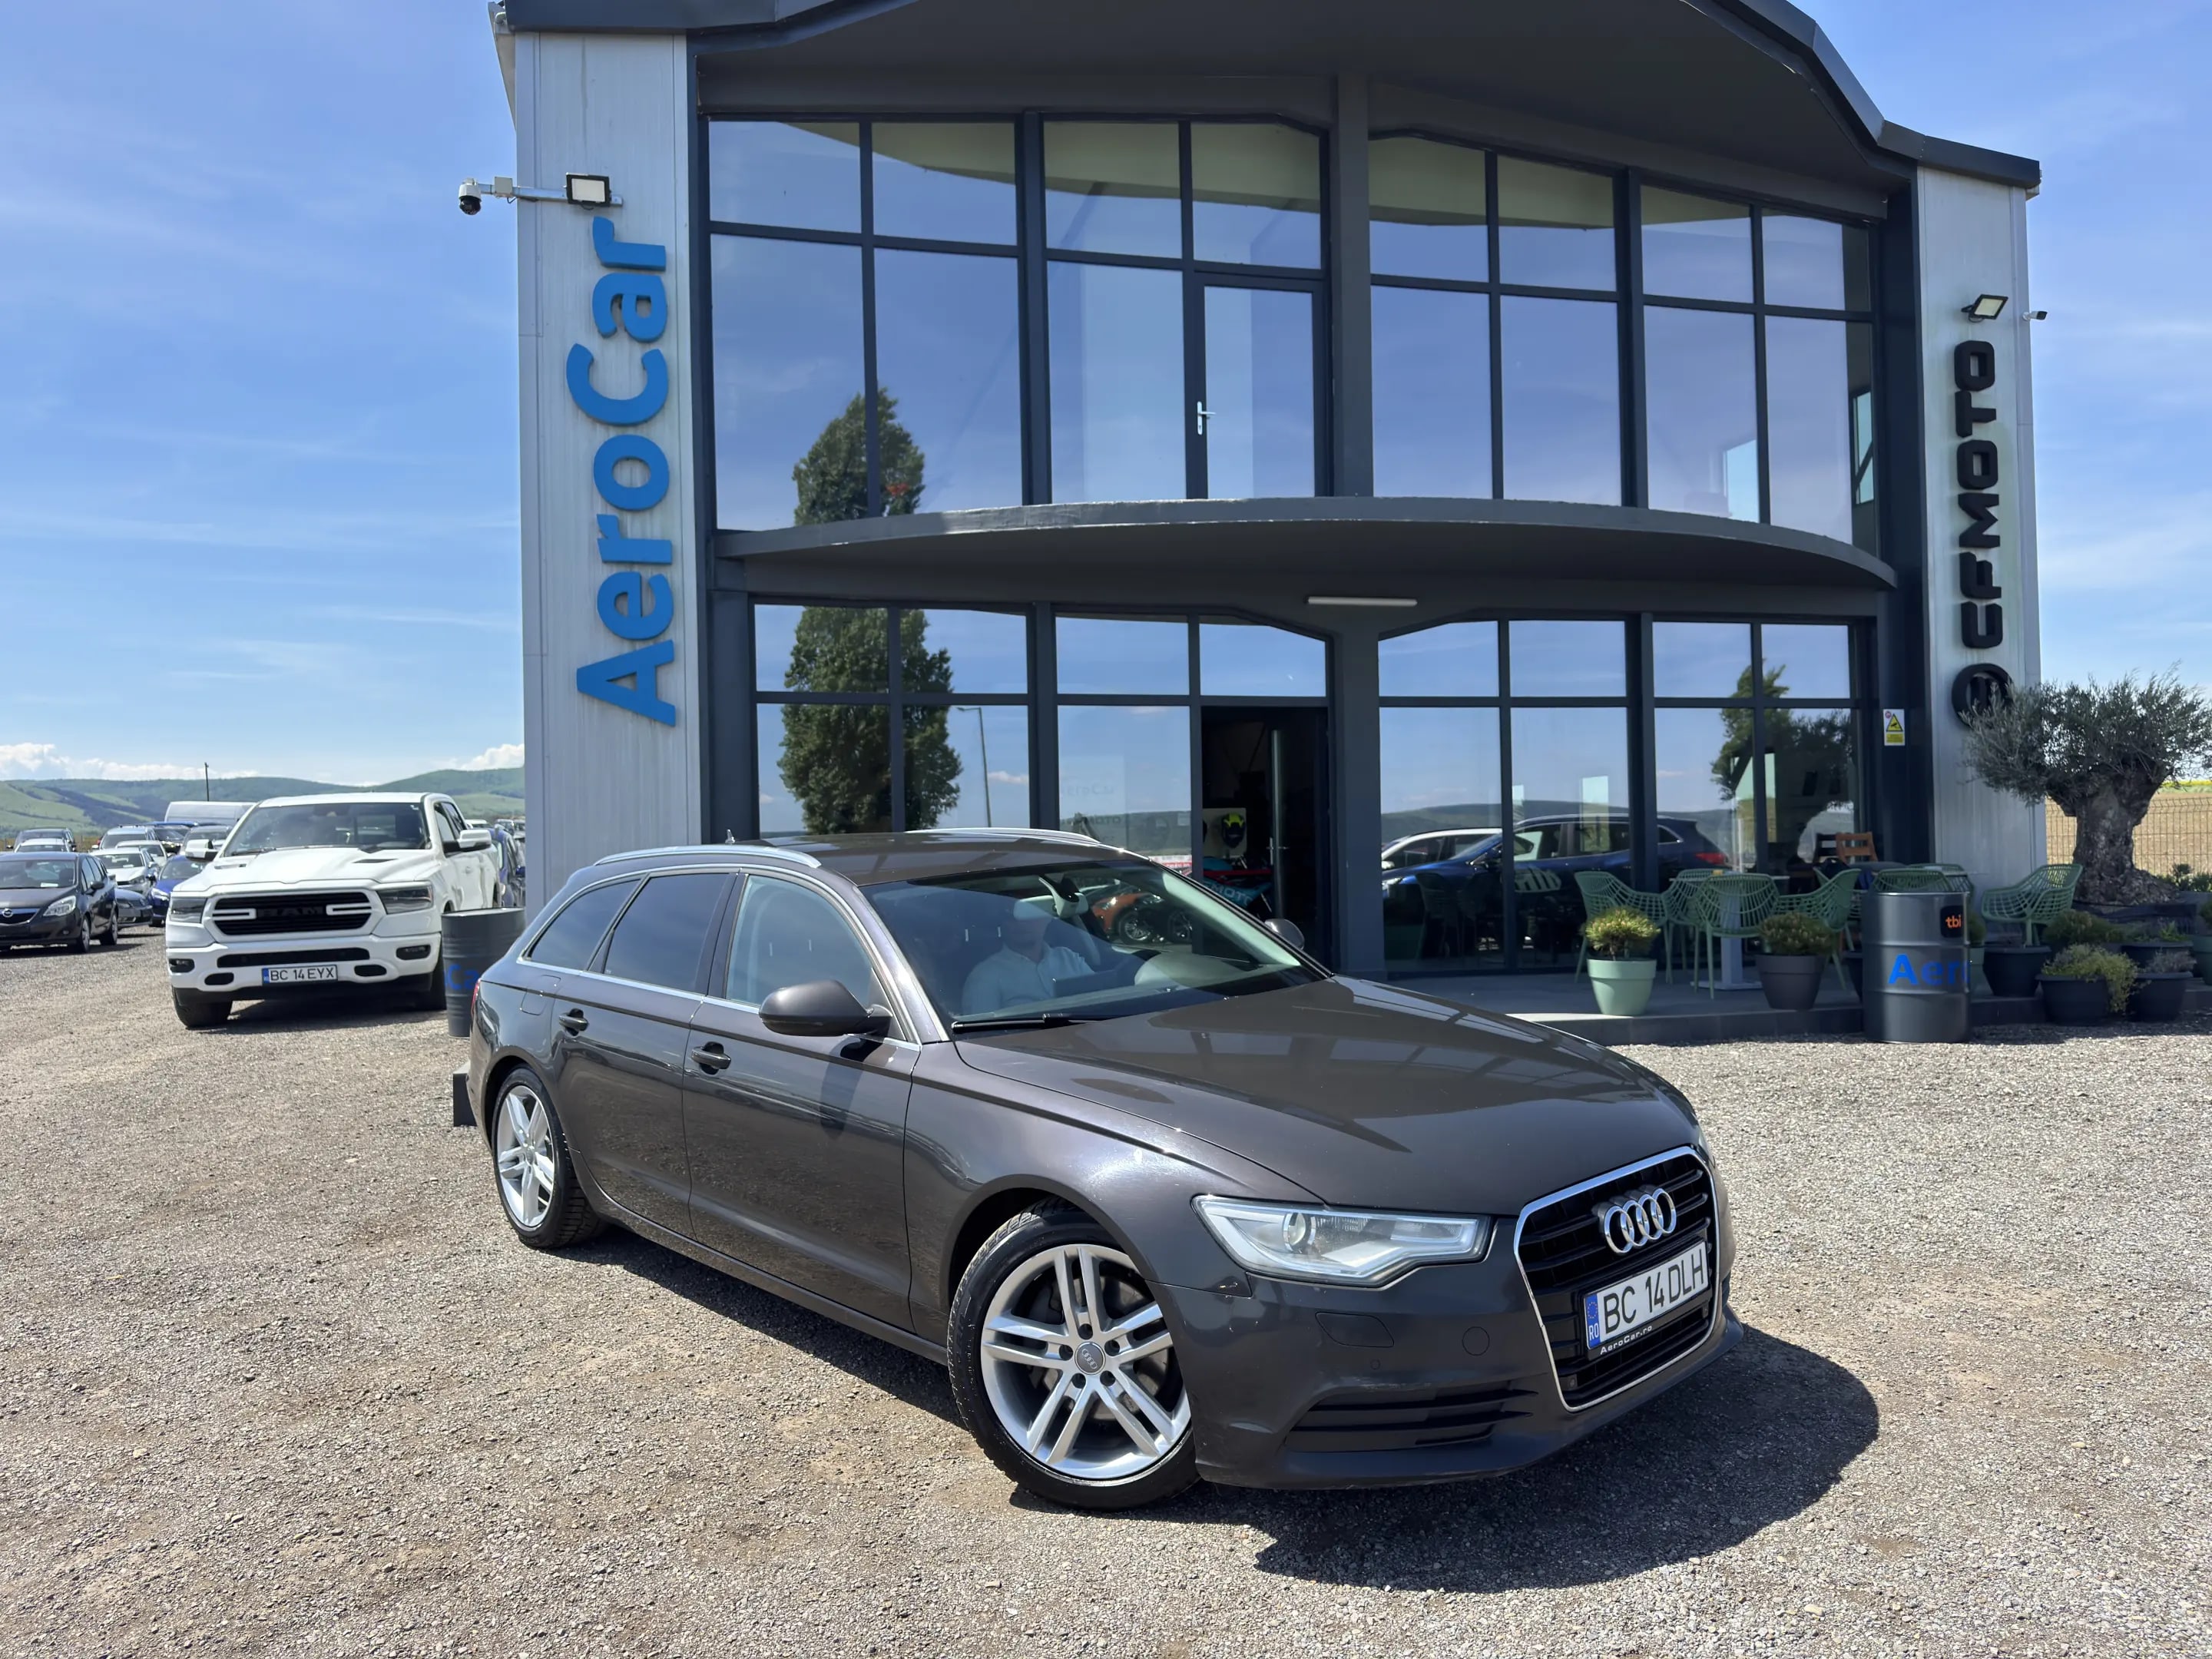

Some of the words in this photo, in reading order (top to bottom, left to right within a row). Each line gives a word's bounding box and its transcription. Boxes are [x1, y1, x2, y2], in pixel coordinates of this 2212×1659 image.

[565, 215, 676, 727] AeroCar
[1953, 340, 2003, 650] CFMOTO
[258, 906, 323, 918] RAM
[1945, 915, 1962, 929] tbi
[270, 970, 289, 982] BC
[293, 969, 305, 980] 14
[307, 967, 334, 979] EYX
[1603, 1285, 1637, 1335] BC
[1645, 1271, 1665, 1313] 14
[1667, 1248, 1704, 1305] DLH
[1588, 1323, 1600, 1342] RO
[1600, 1326, 1653, 1356] AeroCar.ro
